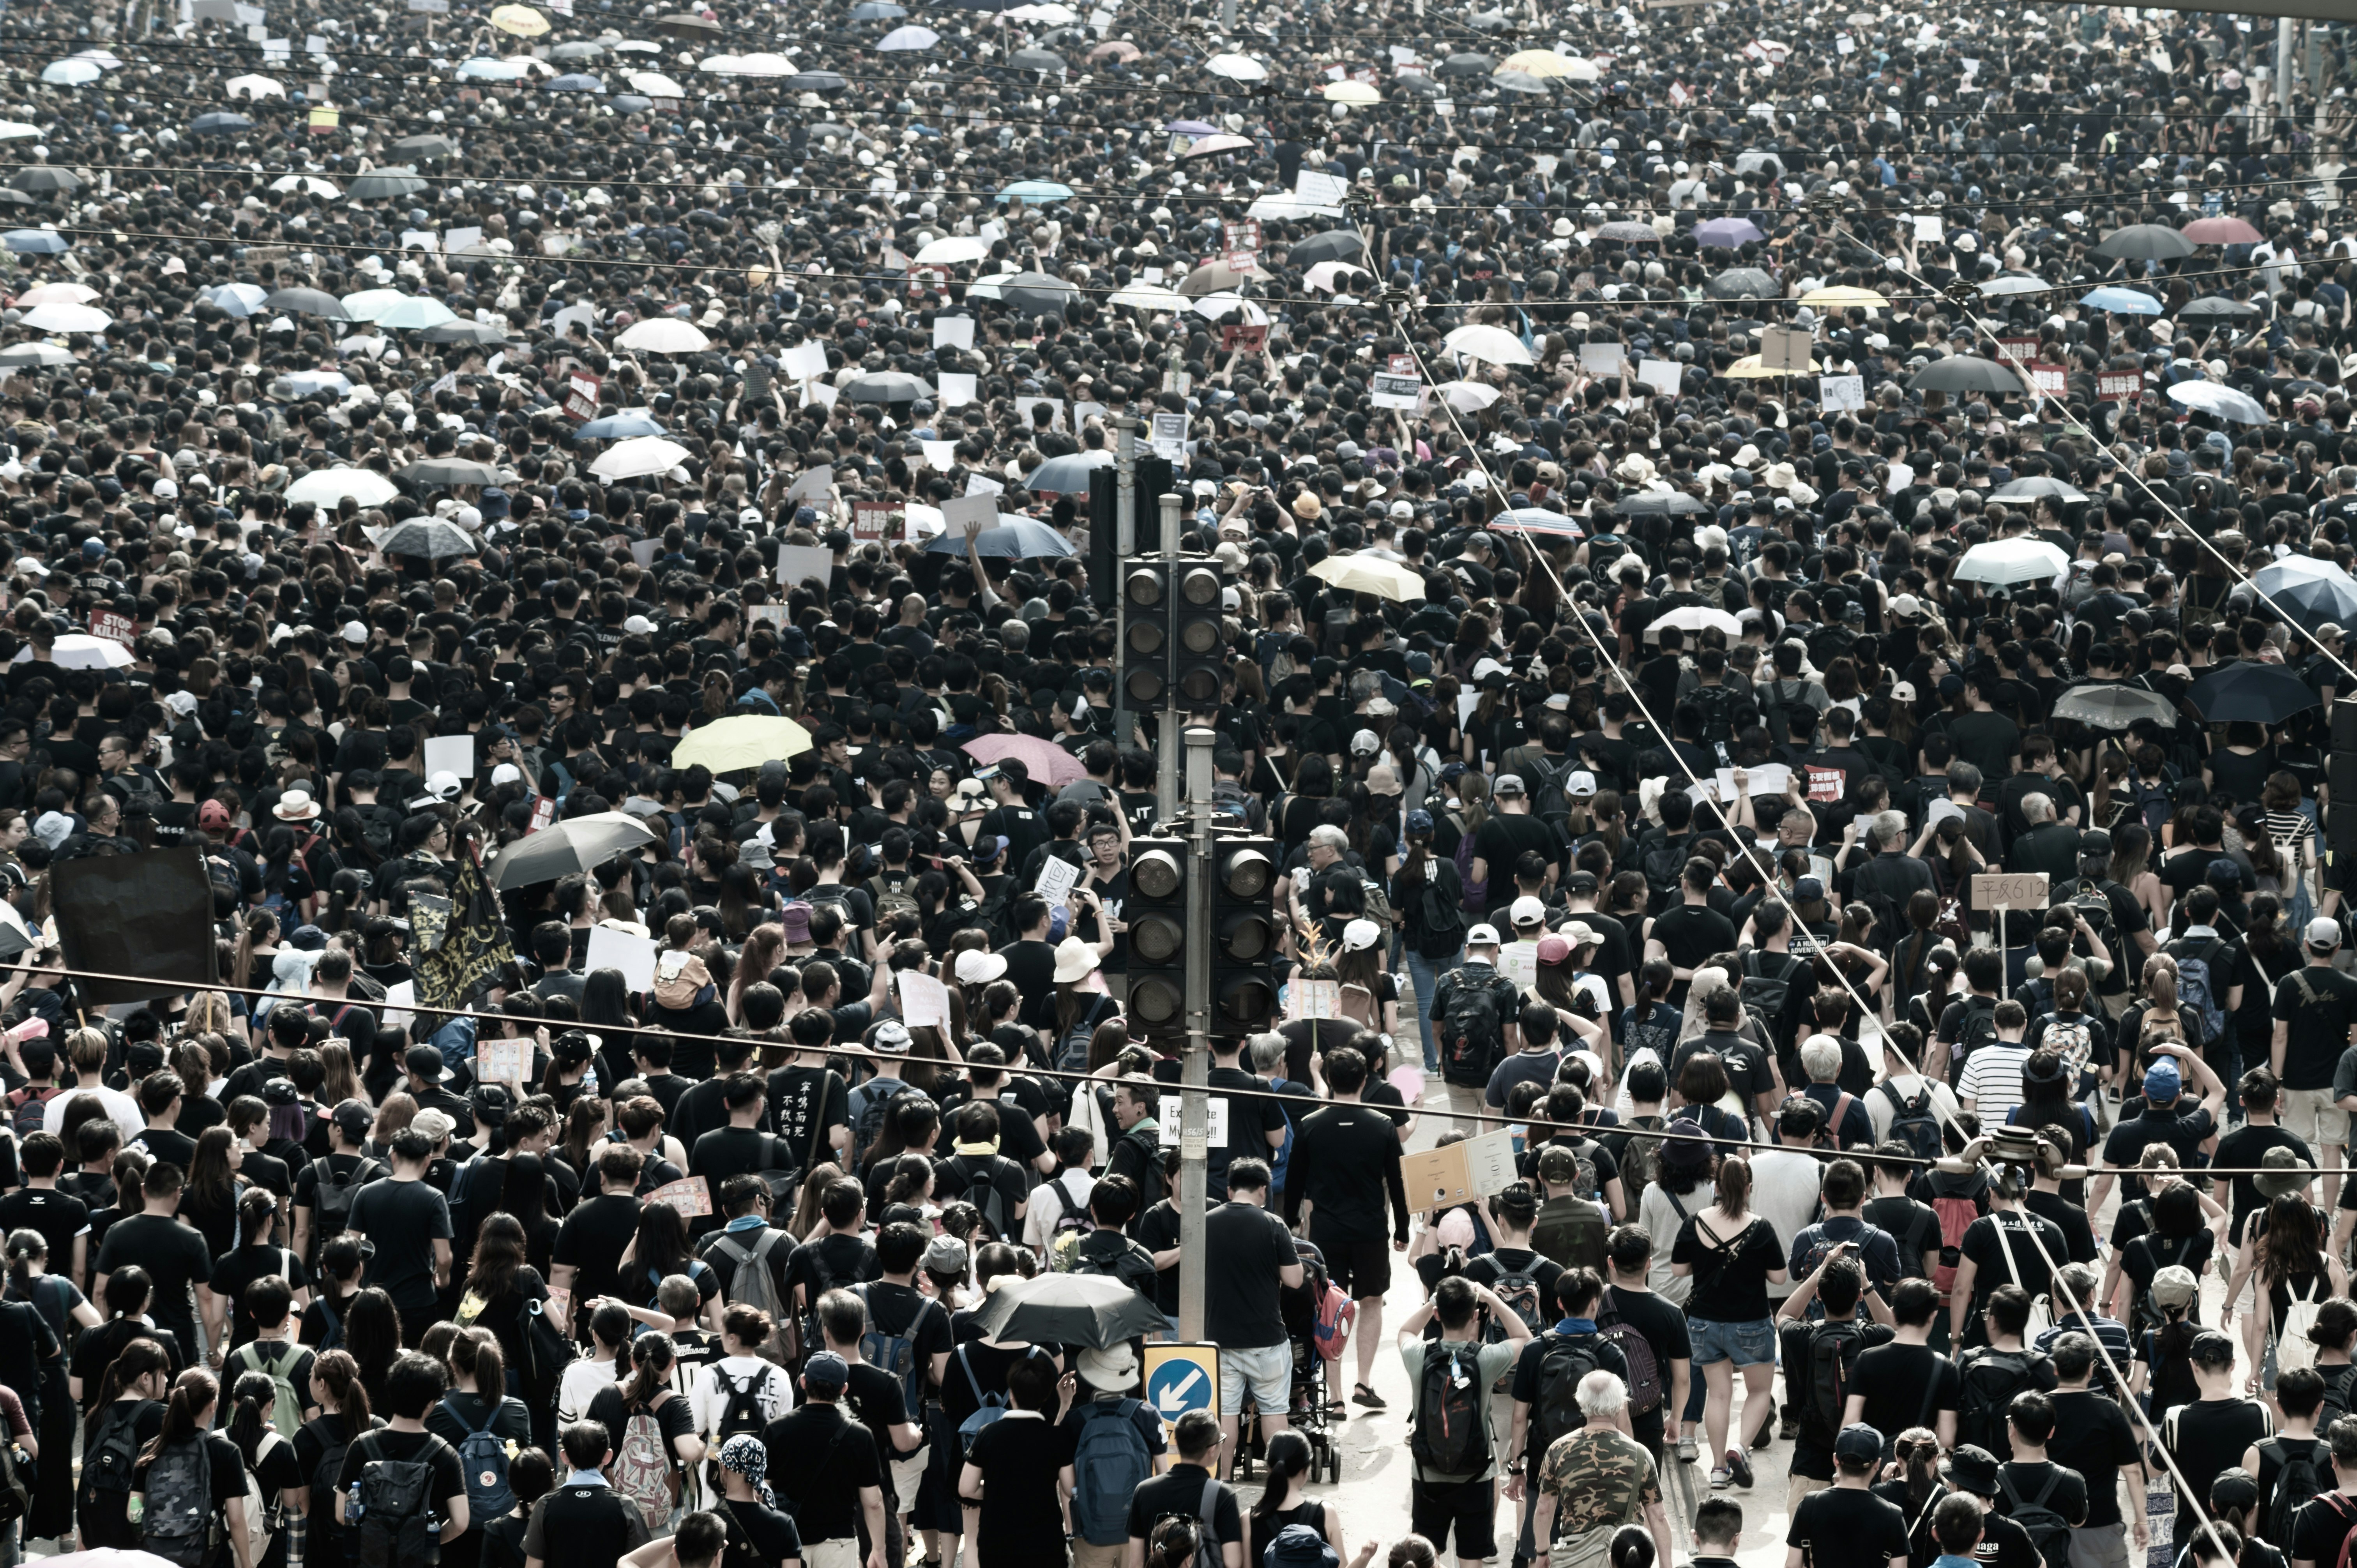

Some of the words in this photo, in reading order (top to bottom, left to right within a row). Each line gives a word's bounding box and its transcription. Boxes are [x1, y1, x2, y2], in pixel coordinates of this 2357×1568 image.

[2101, 375, 2140, 394] 別殺我
[857, 509, 905, 532] 別殺
[102, 613, 133, 630] STOP
[92, 623, 136, 648] KILLING
[539, 800, 553, 816] STOP
[1977, 879, 2048, 905] 平反612
[794, 1081, 812, 1137] 寧鳴而死
